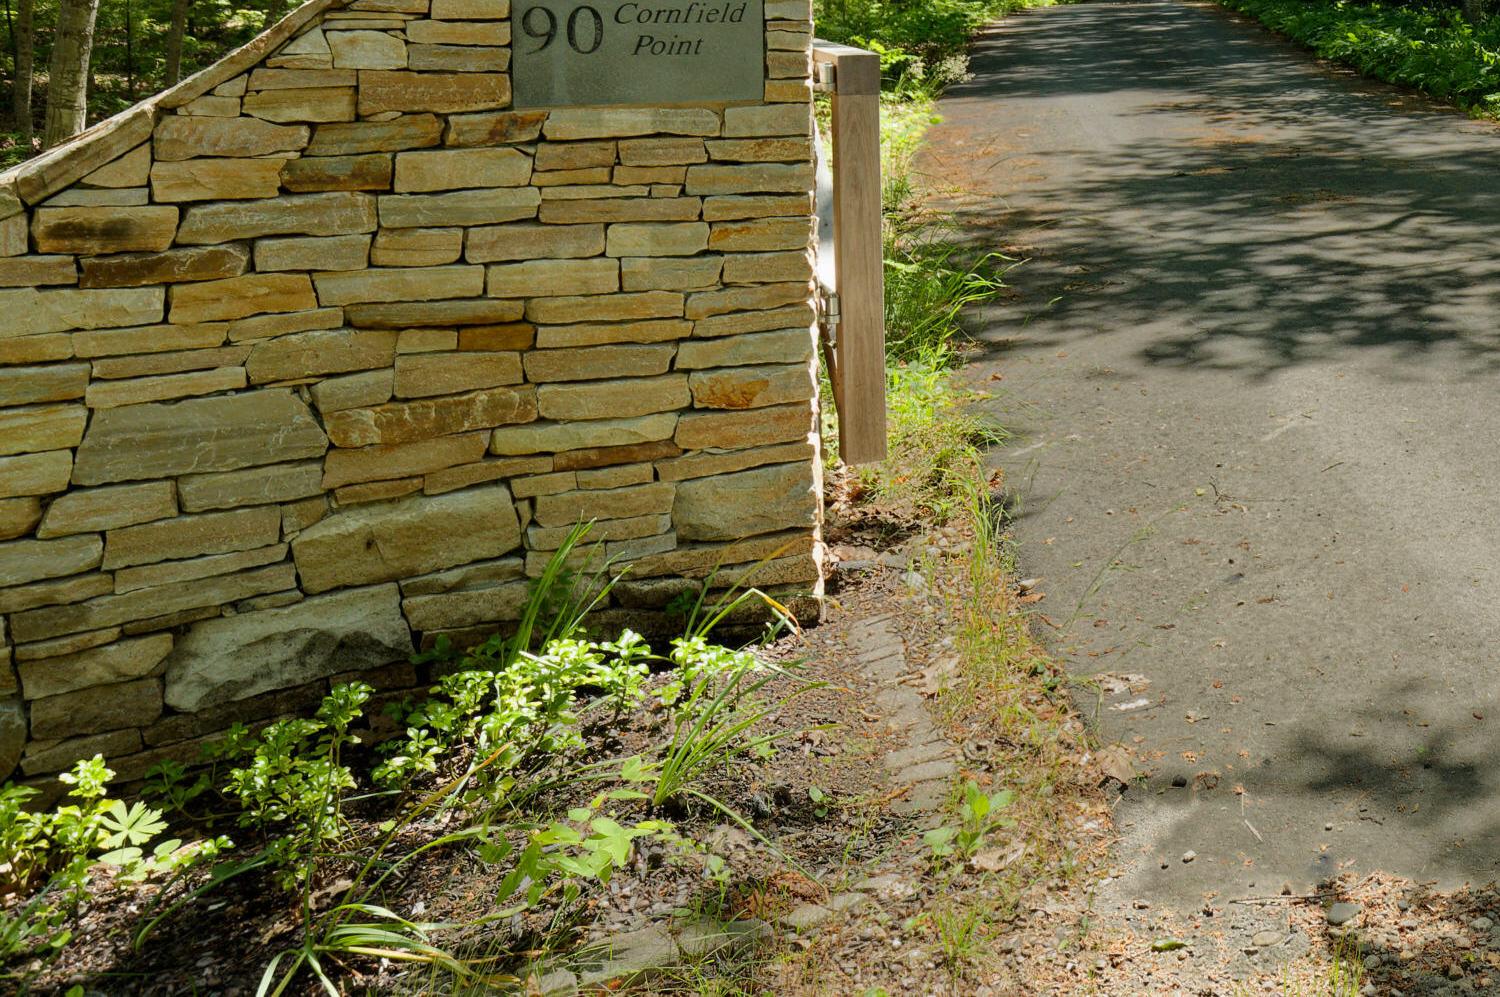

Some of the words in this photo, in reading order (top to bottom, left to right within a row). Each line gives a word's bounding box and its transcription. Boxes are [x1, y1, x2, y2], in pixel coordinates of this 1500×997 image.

[614, 2, 747, 24] Cornfield
[522, 6, 604, 55] 90
[631, 34, 704, 56] Point
